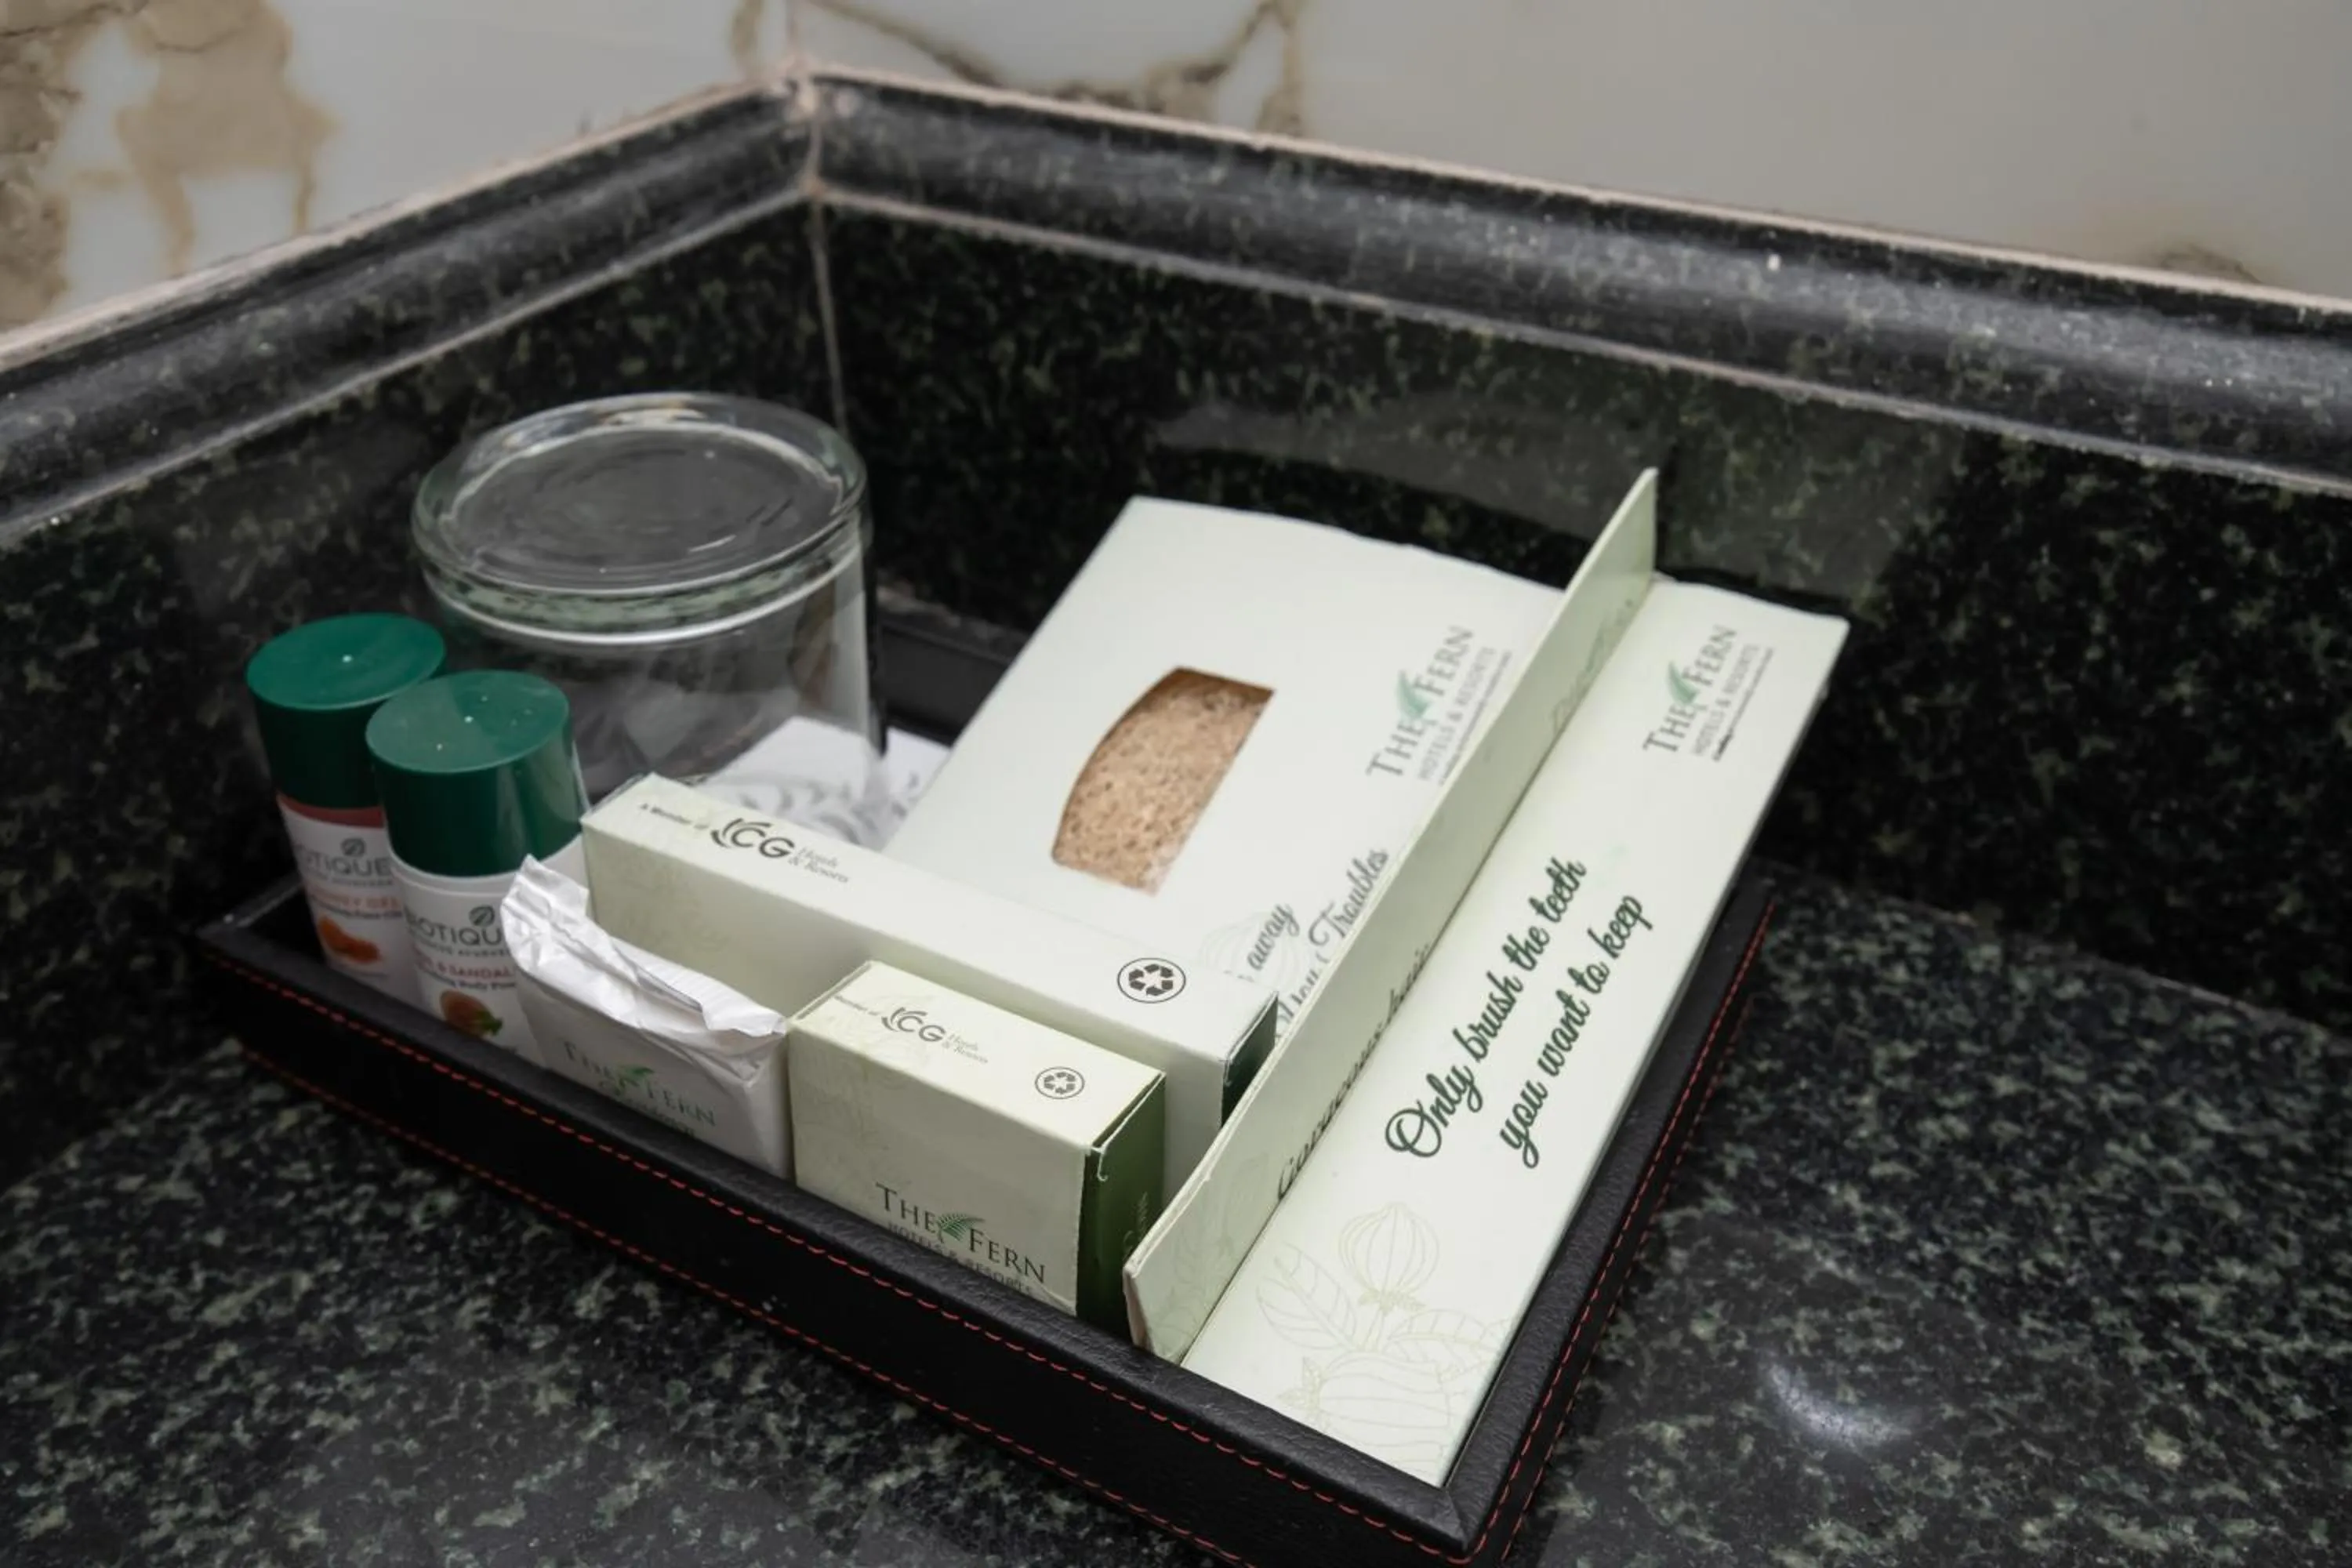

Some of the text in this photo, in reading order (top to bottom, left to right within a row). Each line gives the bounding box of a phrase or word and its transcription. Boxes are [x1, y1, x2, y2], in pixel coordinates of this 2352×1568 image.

[1364, 625, 1474, 776] THE FERN
[1642, 624, 1737, 753] THE FERN
[1246, 904, 1301, 971] away
[1308, 848, 1388, 947] Troubles
[1385, 857, 1587, 1159] Only brush the teeth
[1499, 895, 1653, 1169] you want to keep
[875, 1181, 1046, 1284] THE FERN
